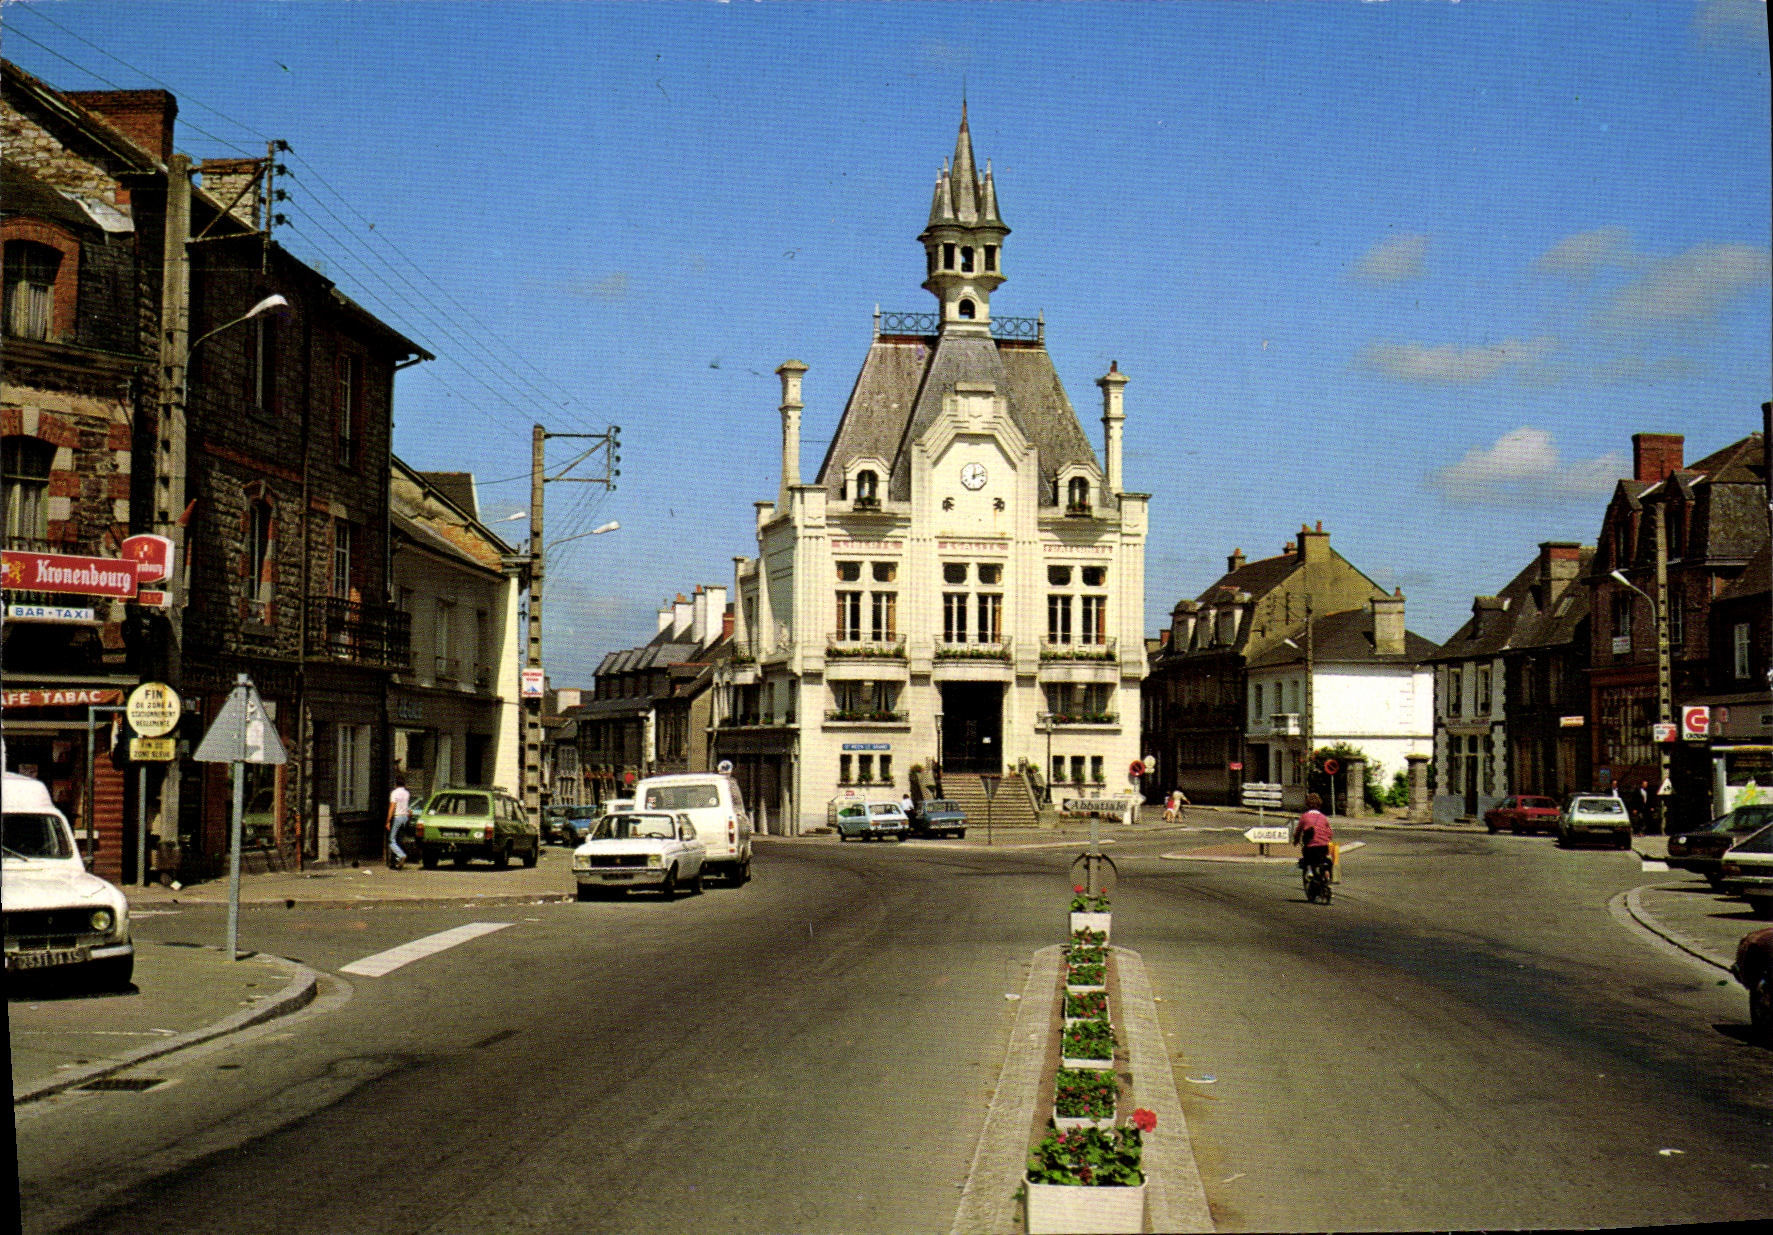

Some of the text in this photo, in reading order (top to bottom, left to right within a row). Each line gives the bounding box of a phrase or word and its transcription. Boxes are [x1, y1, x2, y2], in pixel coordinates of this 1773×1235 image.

[36, 559, 132, 592] Kronenbourg
[15, 607, 45, 617] BAR
[55, 608, 89, 619] TAXI
[2, 690, 101, 705] AFE TABAC
[145, 689, 163, 699] FIN
